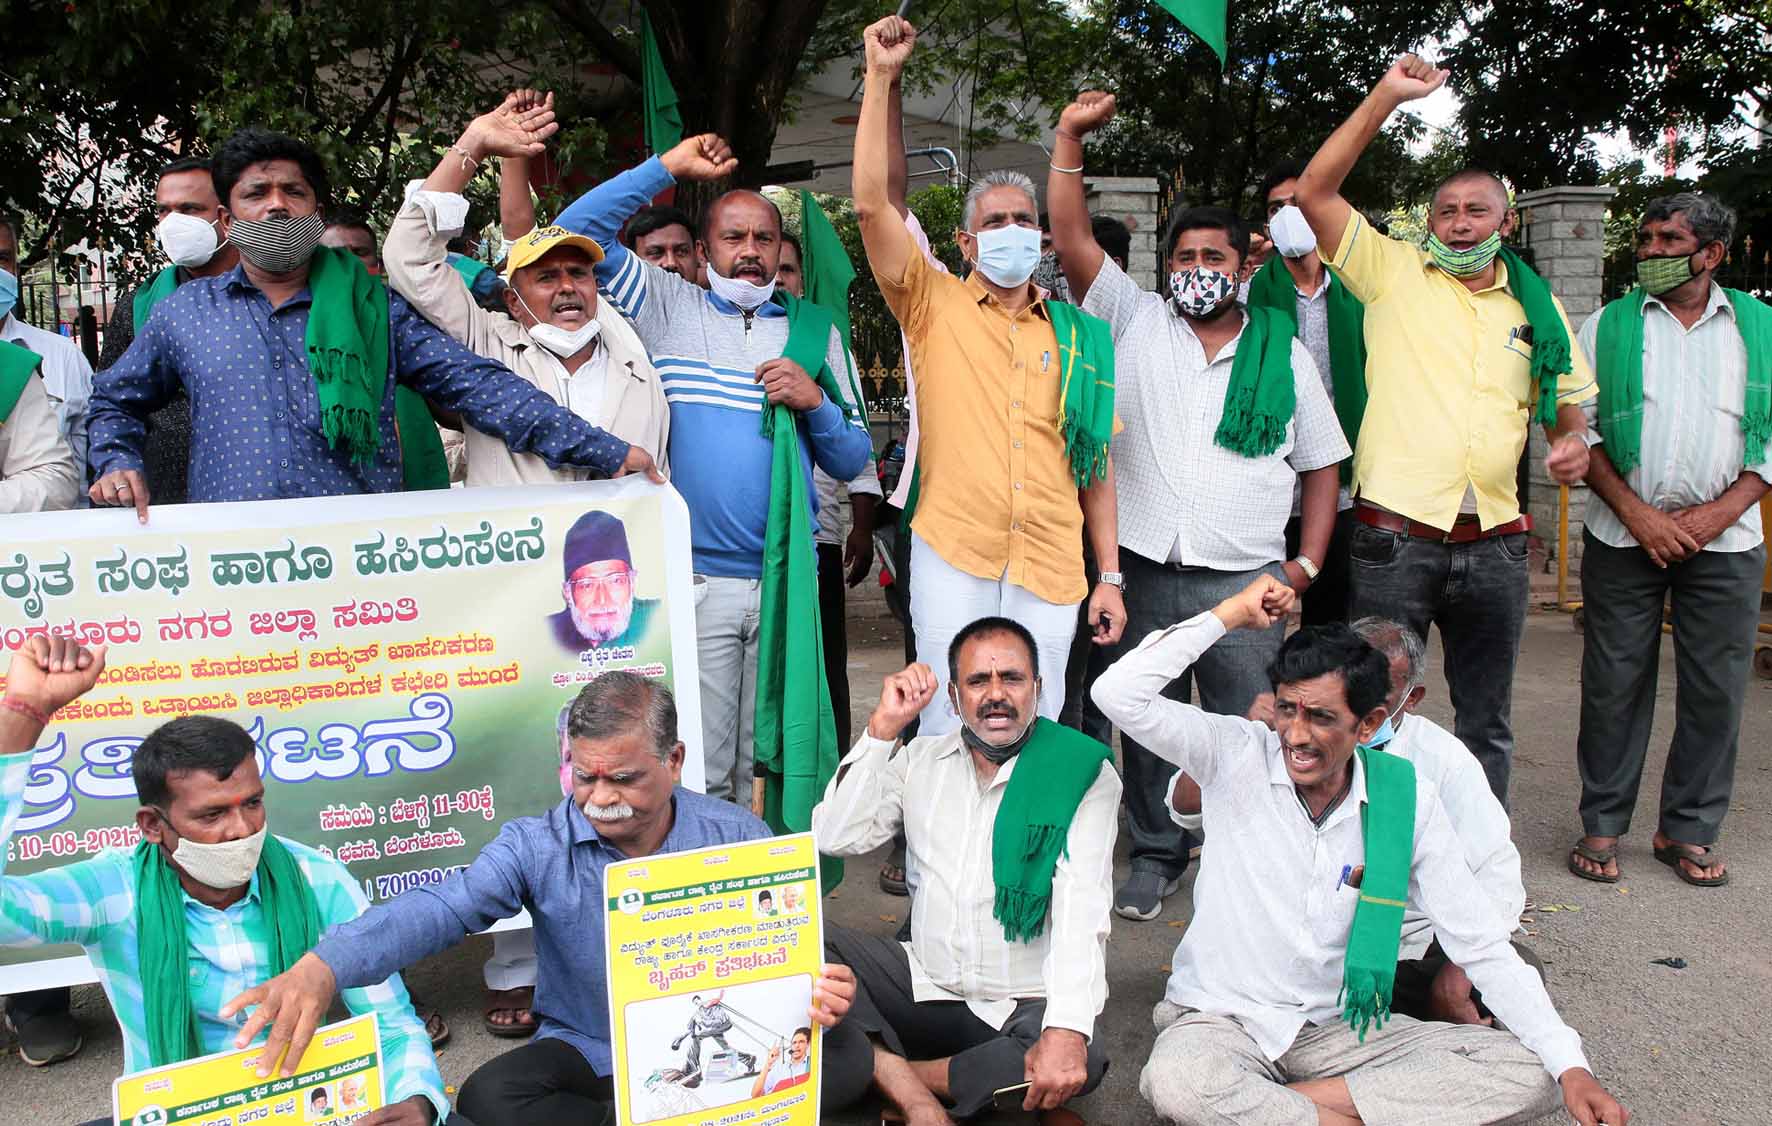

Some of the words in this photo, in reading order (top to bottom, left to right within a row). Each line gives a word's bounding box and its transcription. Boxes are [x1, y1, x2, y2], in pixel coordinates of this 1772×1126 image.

[0, 551, 74, 618] ರೈತ
[96, 544, 190, 596] ಸಂಘ
[211, 538, 333, 586] ಹಾಗೂ
[354, 516, 546, 575] ಹಸಿರುಸೇನೆ
[159, 608, 232, 641] ನಗರ
[250, 608, 319, 641] ಜಿಲ್ಲಾ
[333, 597, 418, 631] ಸಮಿತಿ
[191, 650, 299, 678] ಹೊರಟಿರುವ
[309, 643, 378, 673] ವಿದ್ಯುತ್
[247, 674, 382, 710] ಜಿಲ್ಲಾಧಿಕಾರಿಗಳ
[458, 662, 519, 688] ಮುಂದೆ
[321, 804, 374, 829] ಸಮಯ
